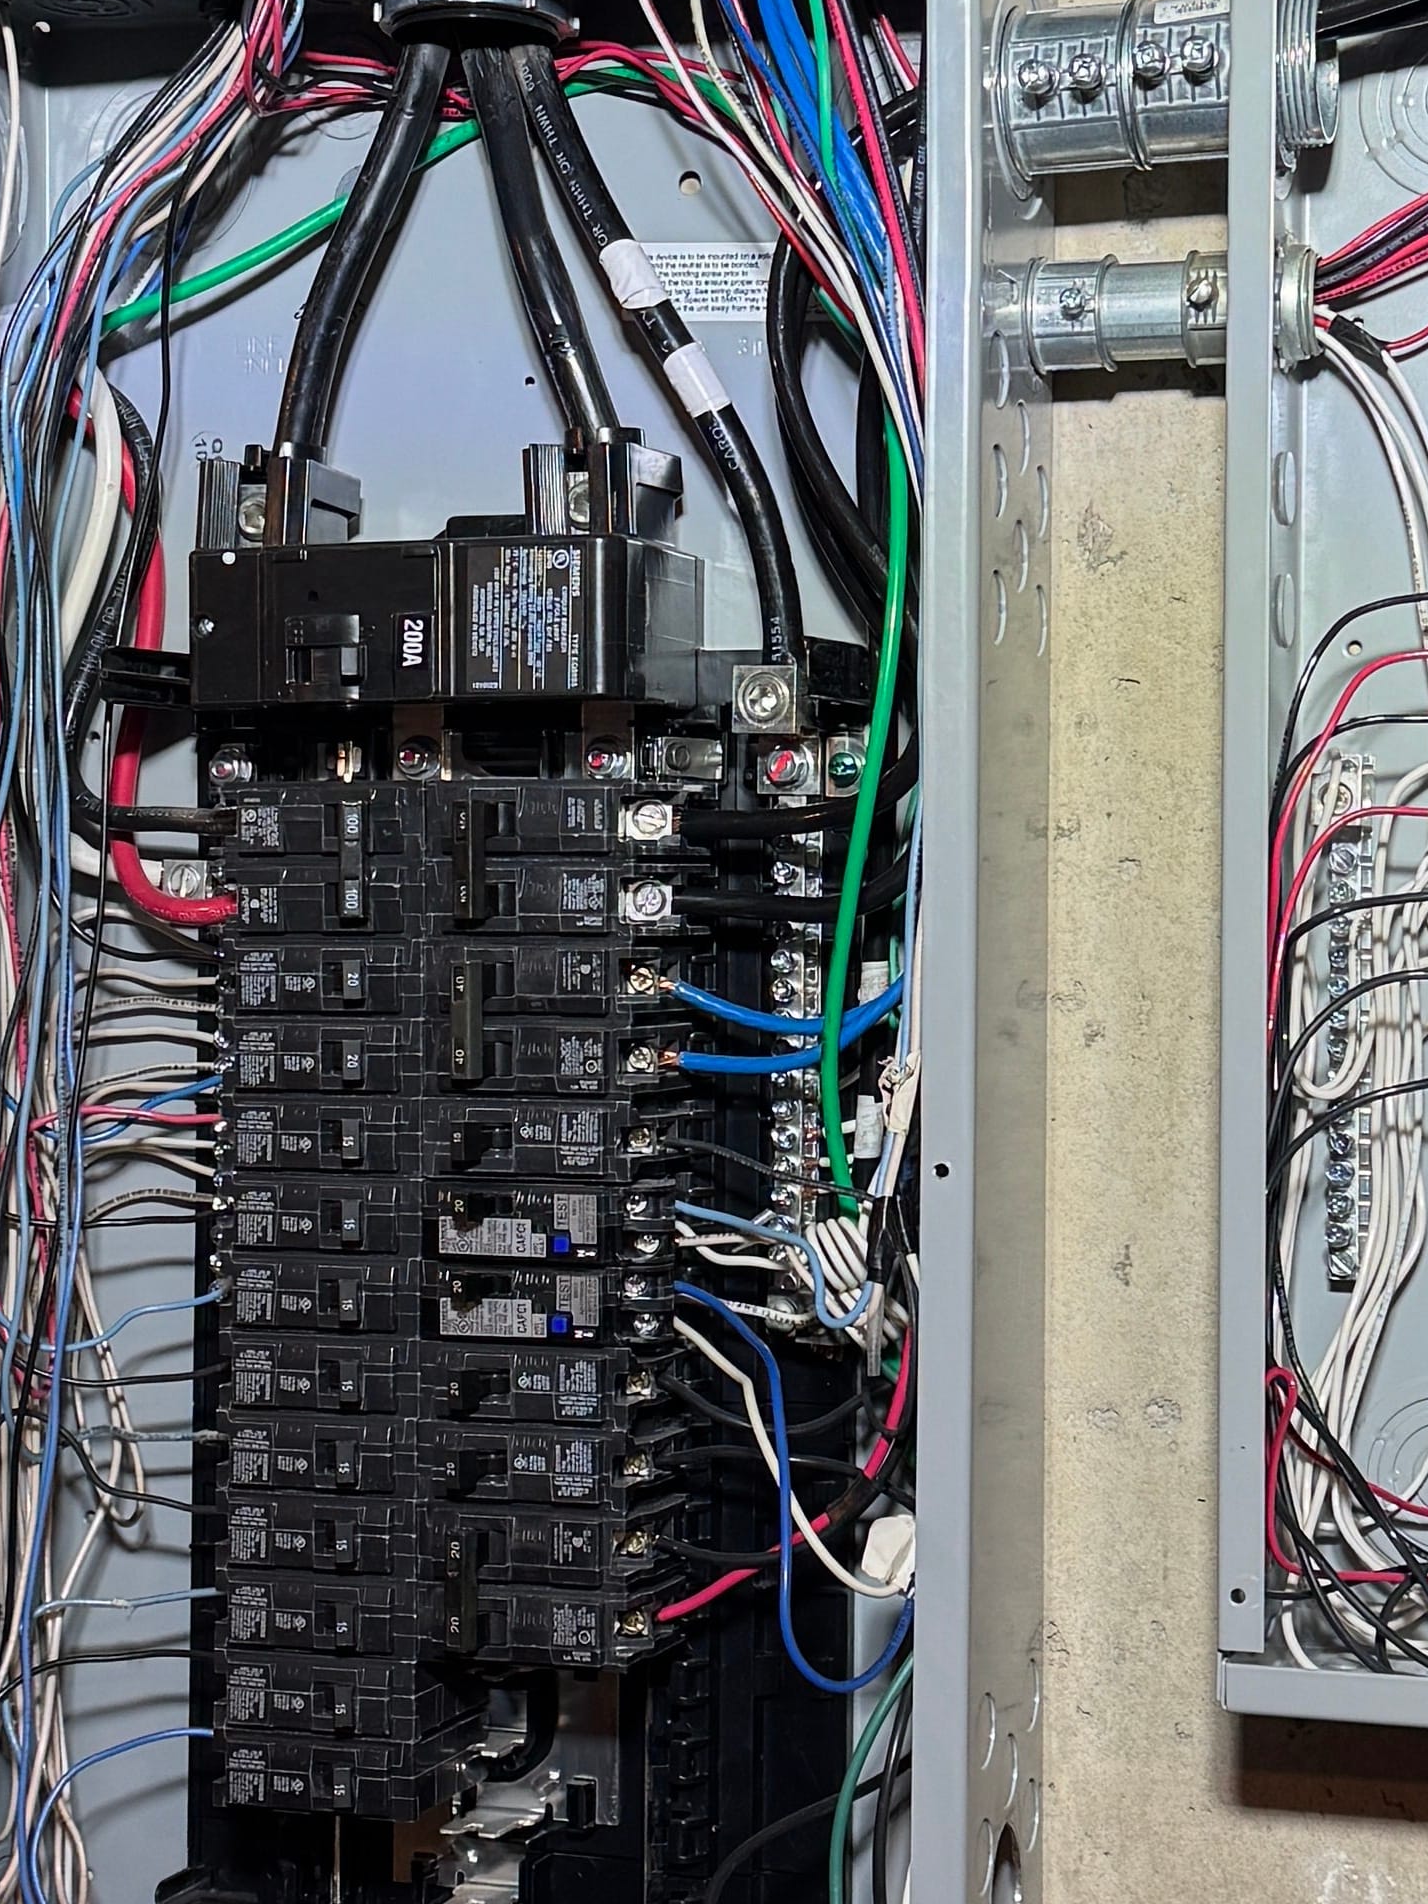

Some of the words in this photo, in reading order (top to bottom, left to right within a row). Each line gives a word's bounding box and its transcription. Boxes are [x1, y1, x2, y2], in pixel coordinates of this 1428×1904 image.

[401, 618, 424, 667] 200A
[345, 813, 359, 835] 100
[345, 888, 359, 909] 100
[347, 972, 359, 988] 20
[346, 1054, 359, 1069] 20
[342, 1135, 355, 1148] 15
[454, 1199, 465, 1214] 20
[556, 1195, 567, 1227] TEST
[343, 1218, 356, 1231] 15
[452, 1279, 462, 1294] 20
[558, 1277, 569, 1309] TEST
[341, 1299, 354, 1312] 15
[341, 1380, 354, 1393] 15
[450, 1381, 459, 1397] 20
[338, 1462, 350, 1475] 15
[446, 1461, 456, 1477] 20
[335, 1539, 348, 1552] 15
[450, 1541, 461, 1560] 20
[335, 1621, 348, 1635] 15
[334, 1703, 347, 1716] 15
[333, 1783, 346, 1797] 15
